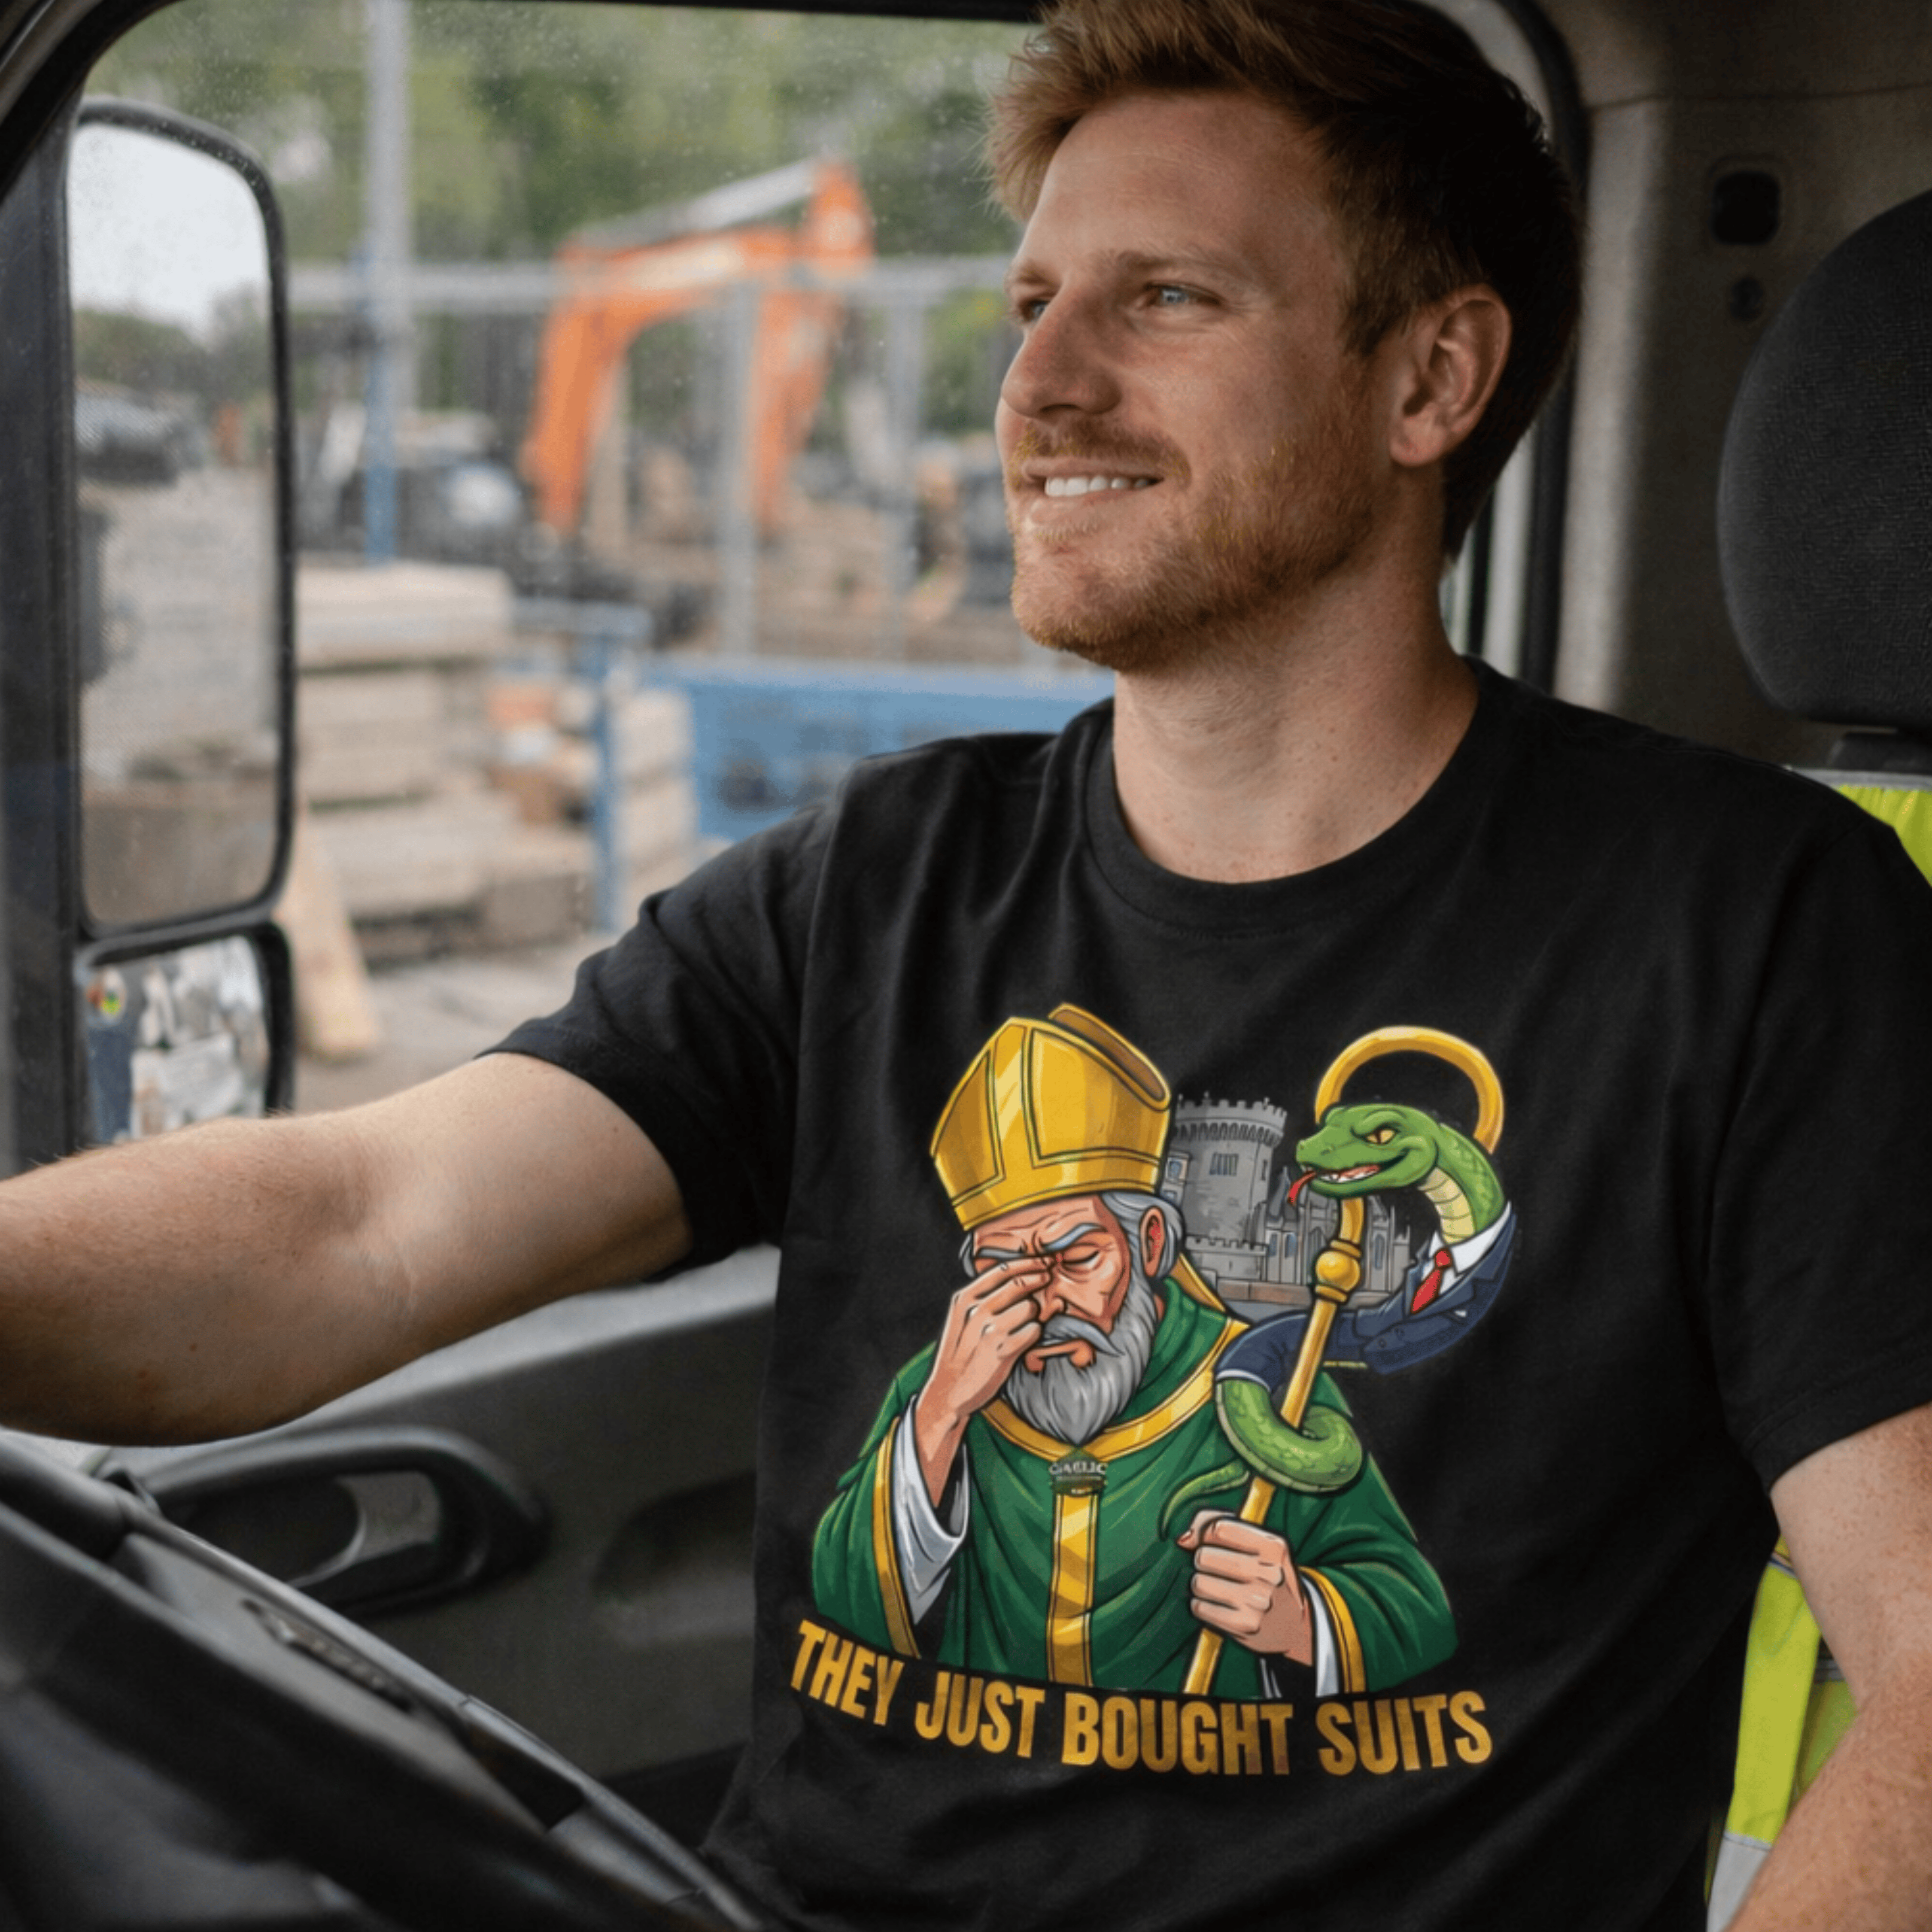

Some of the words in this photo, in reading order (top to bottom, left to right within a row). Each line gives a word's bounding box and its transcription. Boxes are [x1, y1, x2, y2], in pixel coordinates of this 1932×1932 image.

[791, 1619, 905, 1726] THEY
[914, 1671, 1045, 1758] JUST
[1061, 1692, 1294, 1775] BOUGHT
[1317, 1691, 1493, 1775] SUITS
